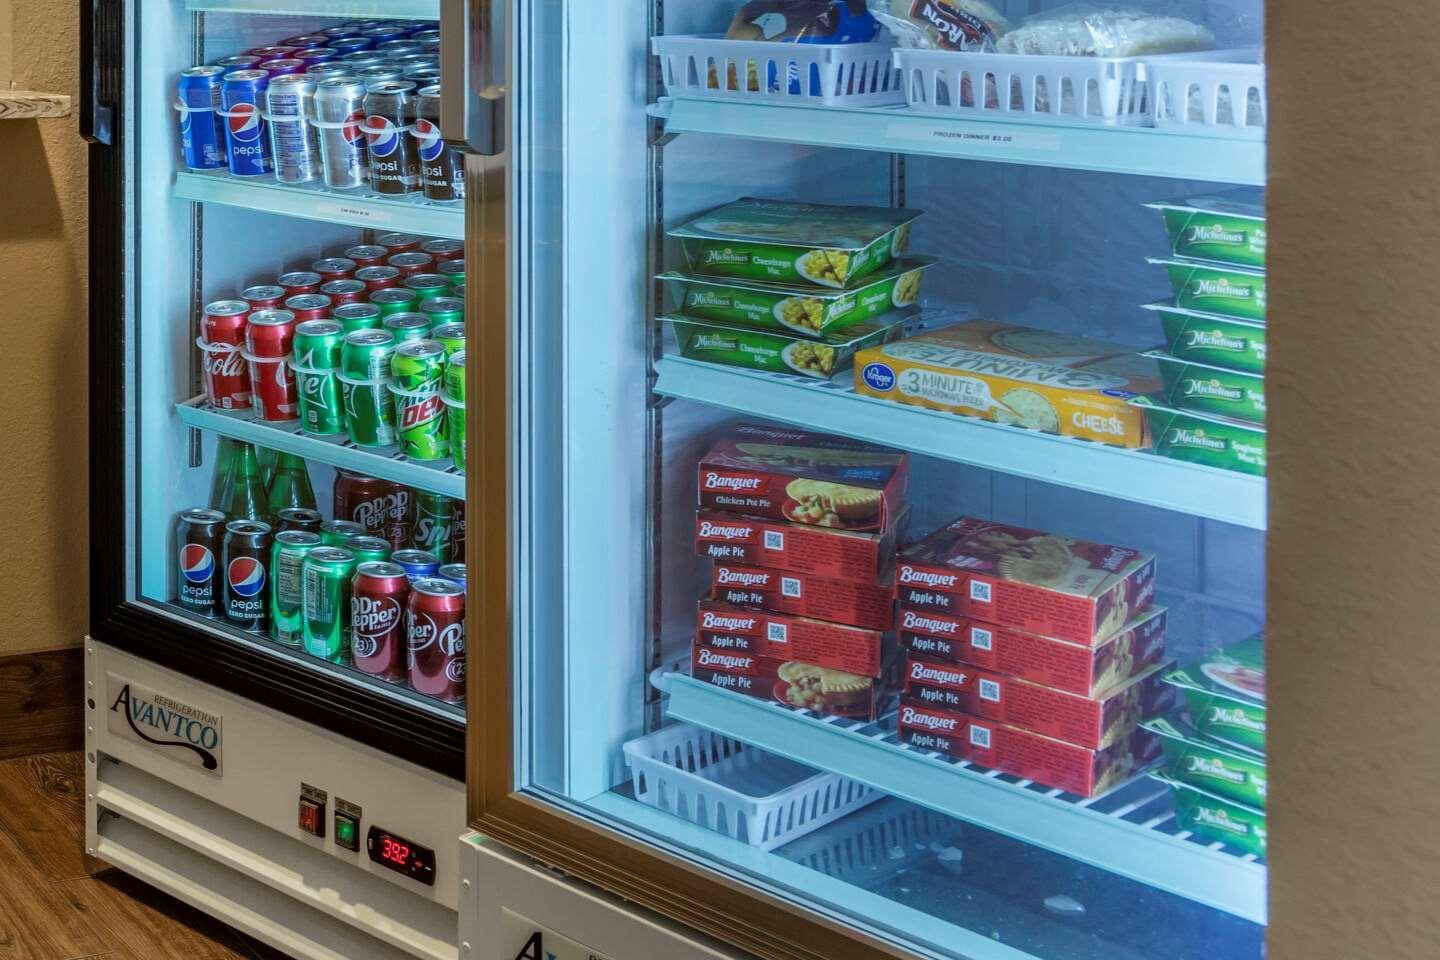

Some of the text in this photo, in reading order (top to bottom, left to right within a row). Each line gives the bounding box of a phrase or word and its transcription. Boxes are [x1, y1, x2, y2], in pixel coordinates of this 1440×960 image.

[1188, 225, 1243, 242] Michelina's
[1193, 279, 1250, 297] Michelina's
[1186, 329, 1246, 350] Michelina's
[867, 367, 892, 387] Kroger
[907, 371, 972, 395] 3 MINUTE
[1184, 379, 1242, 400] Michelina's
[1071, 411, 1125, 437] CHEESE
[1169, 428, 1226, 450] Michelina's
[705, 472, 762, 491] Banquet
[715, 495, 771, 508] Chicken Pot Pie
[699, 521, 753, 540] Banquet
[708, 544, 745, 558] Apple Pie
[717, 567, 771, 587] Banquet
[900, 565, 959, 587] Banquet
[182, 584, 213, 598] pepsi
[727, 590, 764, 604] Apple Pie
[909, 590, 950, 607] Apple Pie
[231, 599, 264, 612] pepsi
[352, 606, 397, 631] epper
[702, 612, 757, 631] Banquet
[903, 611, 961, 633] Banquet
[711, 635, 749, 649] Apple Pie
[912, 636, 951, 654] Apple Pie
[698, 648, 754, 669] Banquet
[711, 672, 752, 689] Apple Pie
[911, 662, 968, 685] Banquet
[920, 687, 960, 705] Apple Pie
[110, 684, 219, 755] AVANTCO
[154, 694, 219, 726] REFRIGERATION
[902, 707, 960, 730] Banquet
[911, 732, 950, 750] Apple Pie
